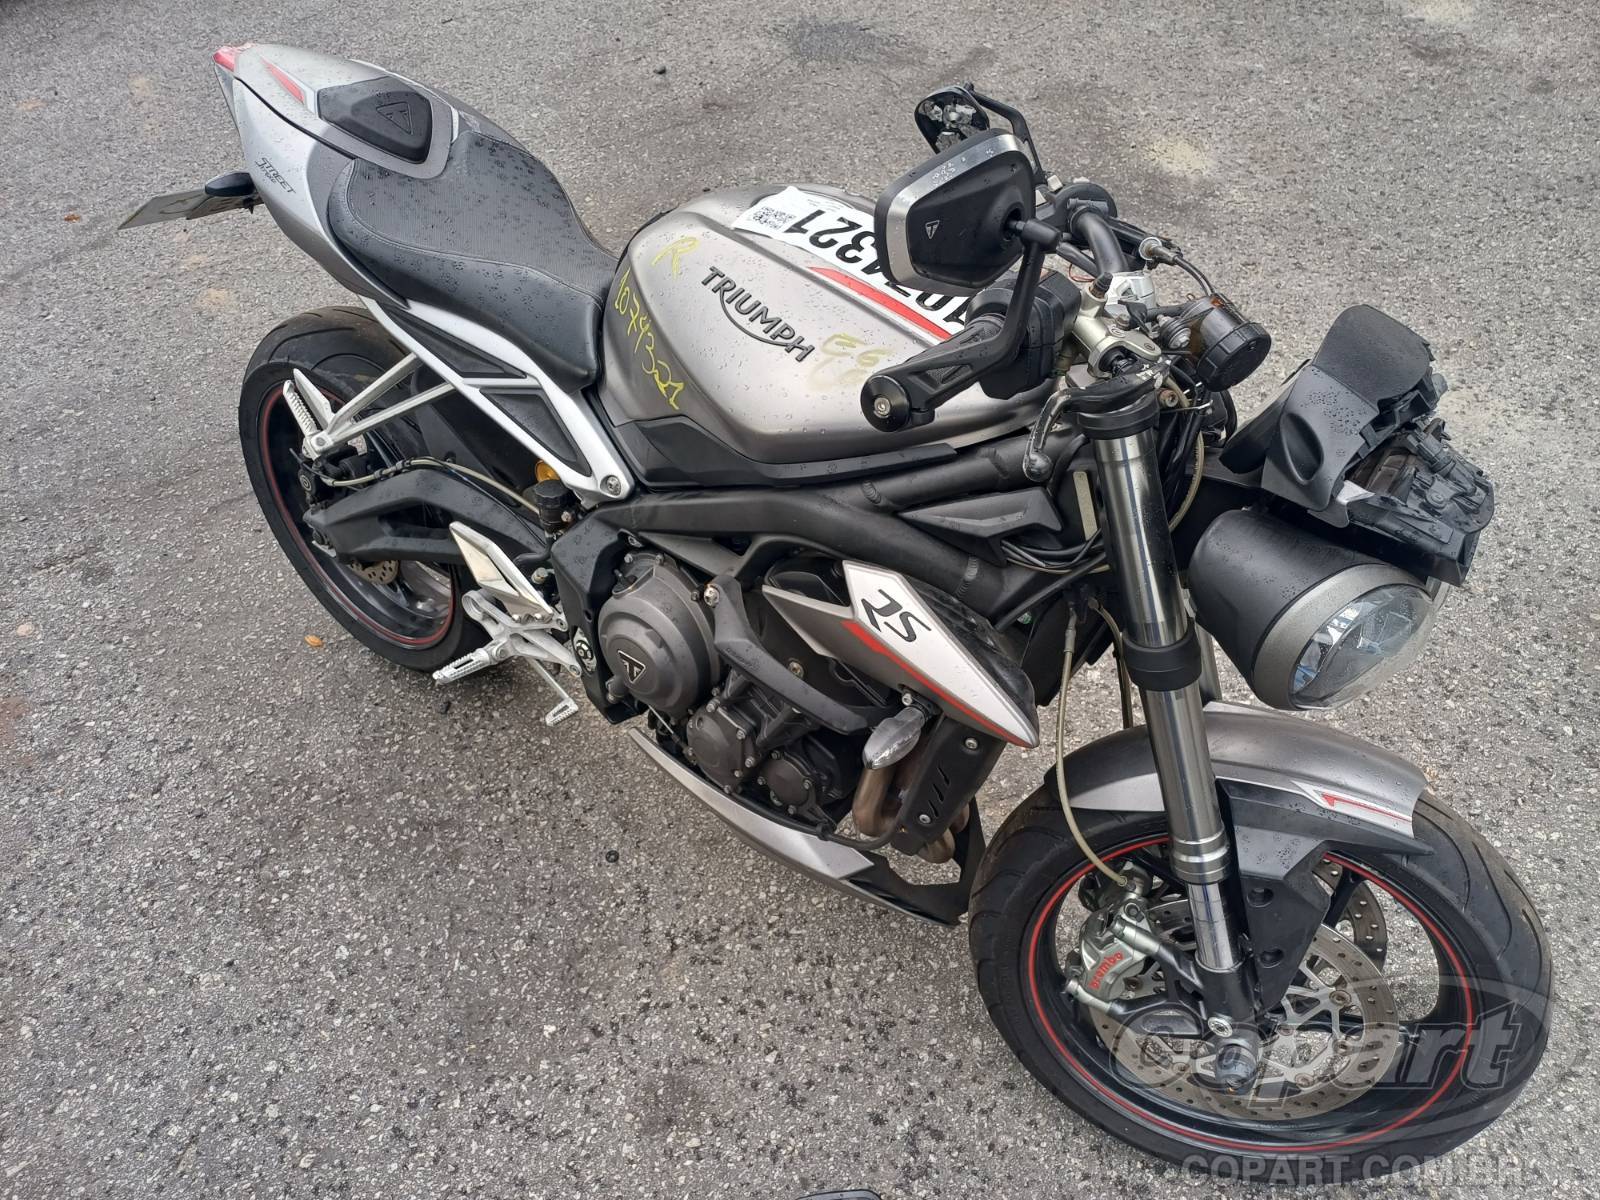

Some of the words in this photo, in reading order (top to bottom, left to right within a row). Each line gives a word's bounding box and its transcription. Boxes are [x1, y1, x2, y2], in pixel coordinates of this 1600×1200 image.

[254, 157, 296, 193] STREET
[700, 266, 815, 362] TRIUMPH
[1088, 950, 1124, 990] brembo
